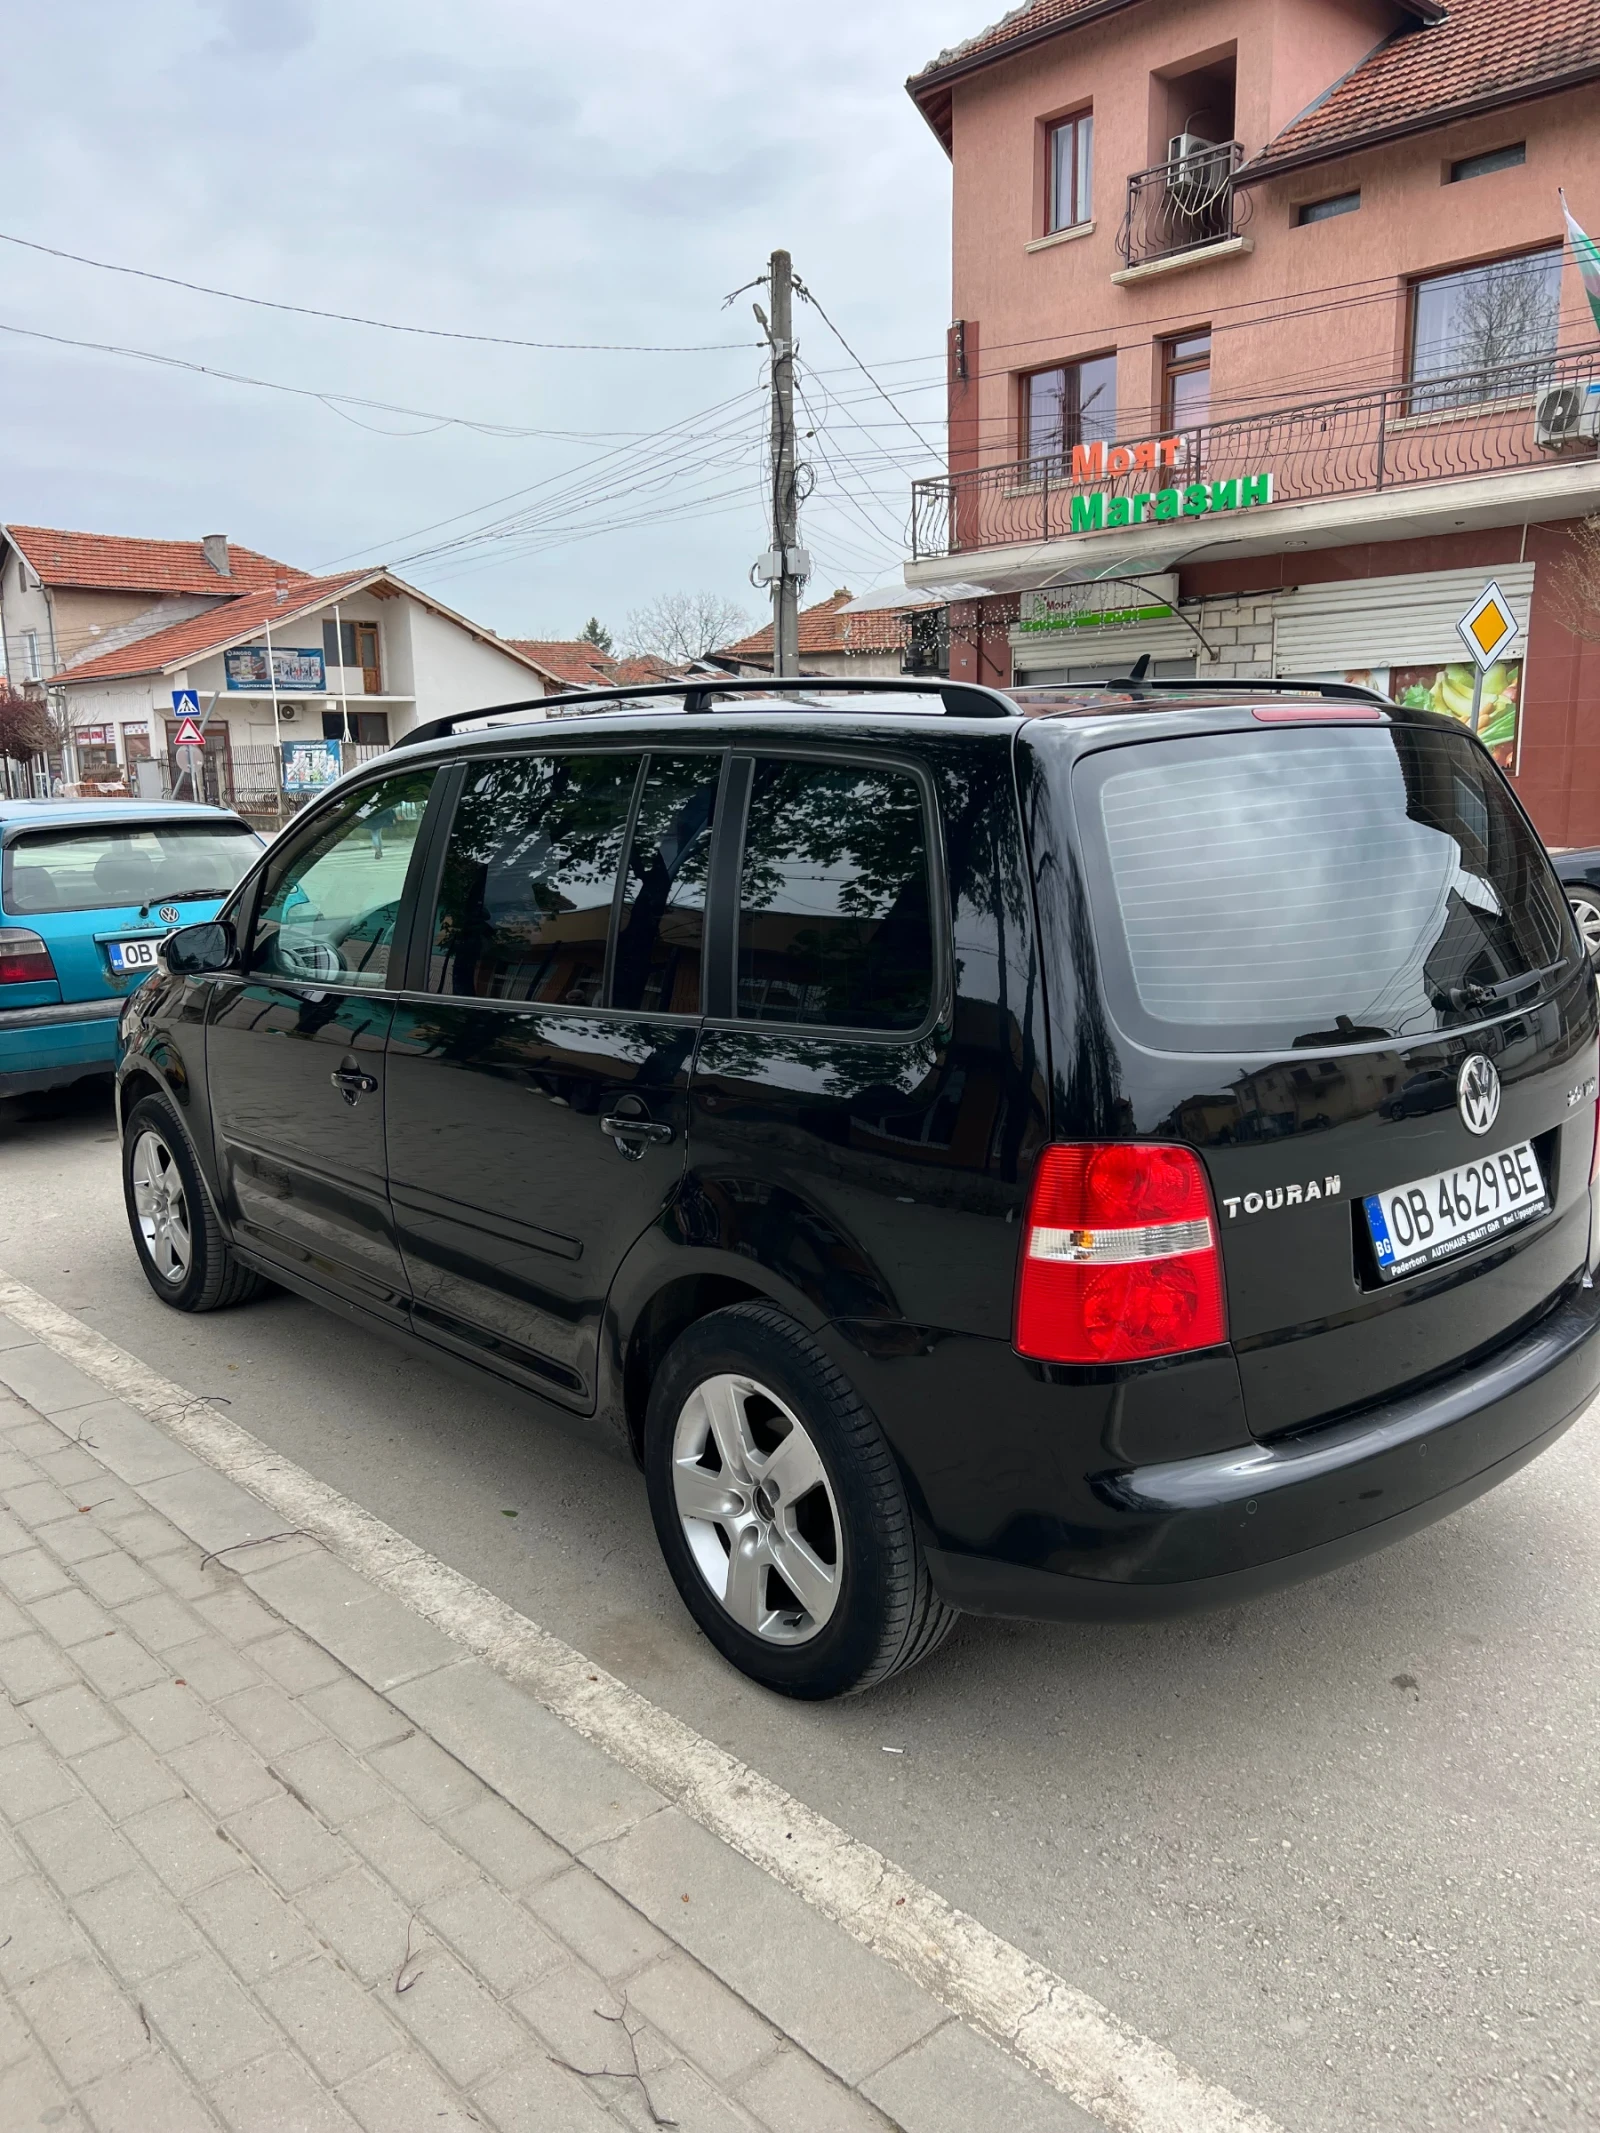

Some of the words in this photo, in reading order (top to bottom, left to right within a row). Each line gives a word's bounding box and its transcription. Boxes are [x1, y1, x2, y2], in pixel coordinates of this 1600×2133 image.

[1072, 438, 1186, 484] Моят
[1071, 473, 1274, 533] Магазин
[1046, 600, 1072, 611] Моят
[1222, 1174, 1342, 1219] TOURAN
[1438, 1161, 1500, 1227] 4629
[1498, 1146, 1539, 1202] BE
[1375, 1238, 1392, 1258] BG
[1390, 1254, 1428, 1276] Paderborn
[1431, 1236, 1467, 1259] AUTOHAUS
[1487, 1219, 1500, 1234] GbR
[1502, 1213, 1515, 1226] Bad
[1514, 1200, 1545, 1222] Lippspringe
